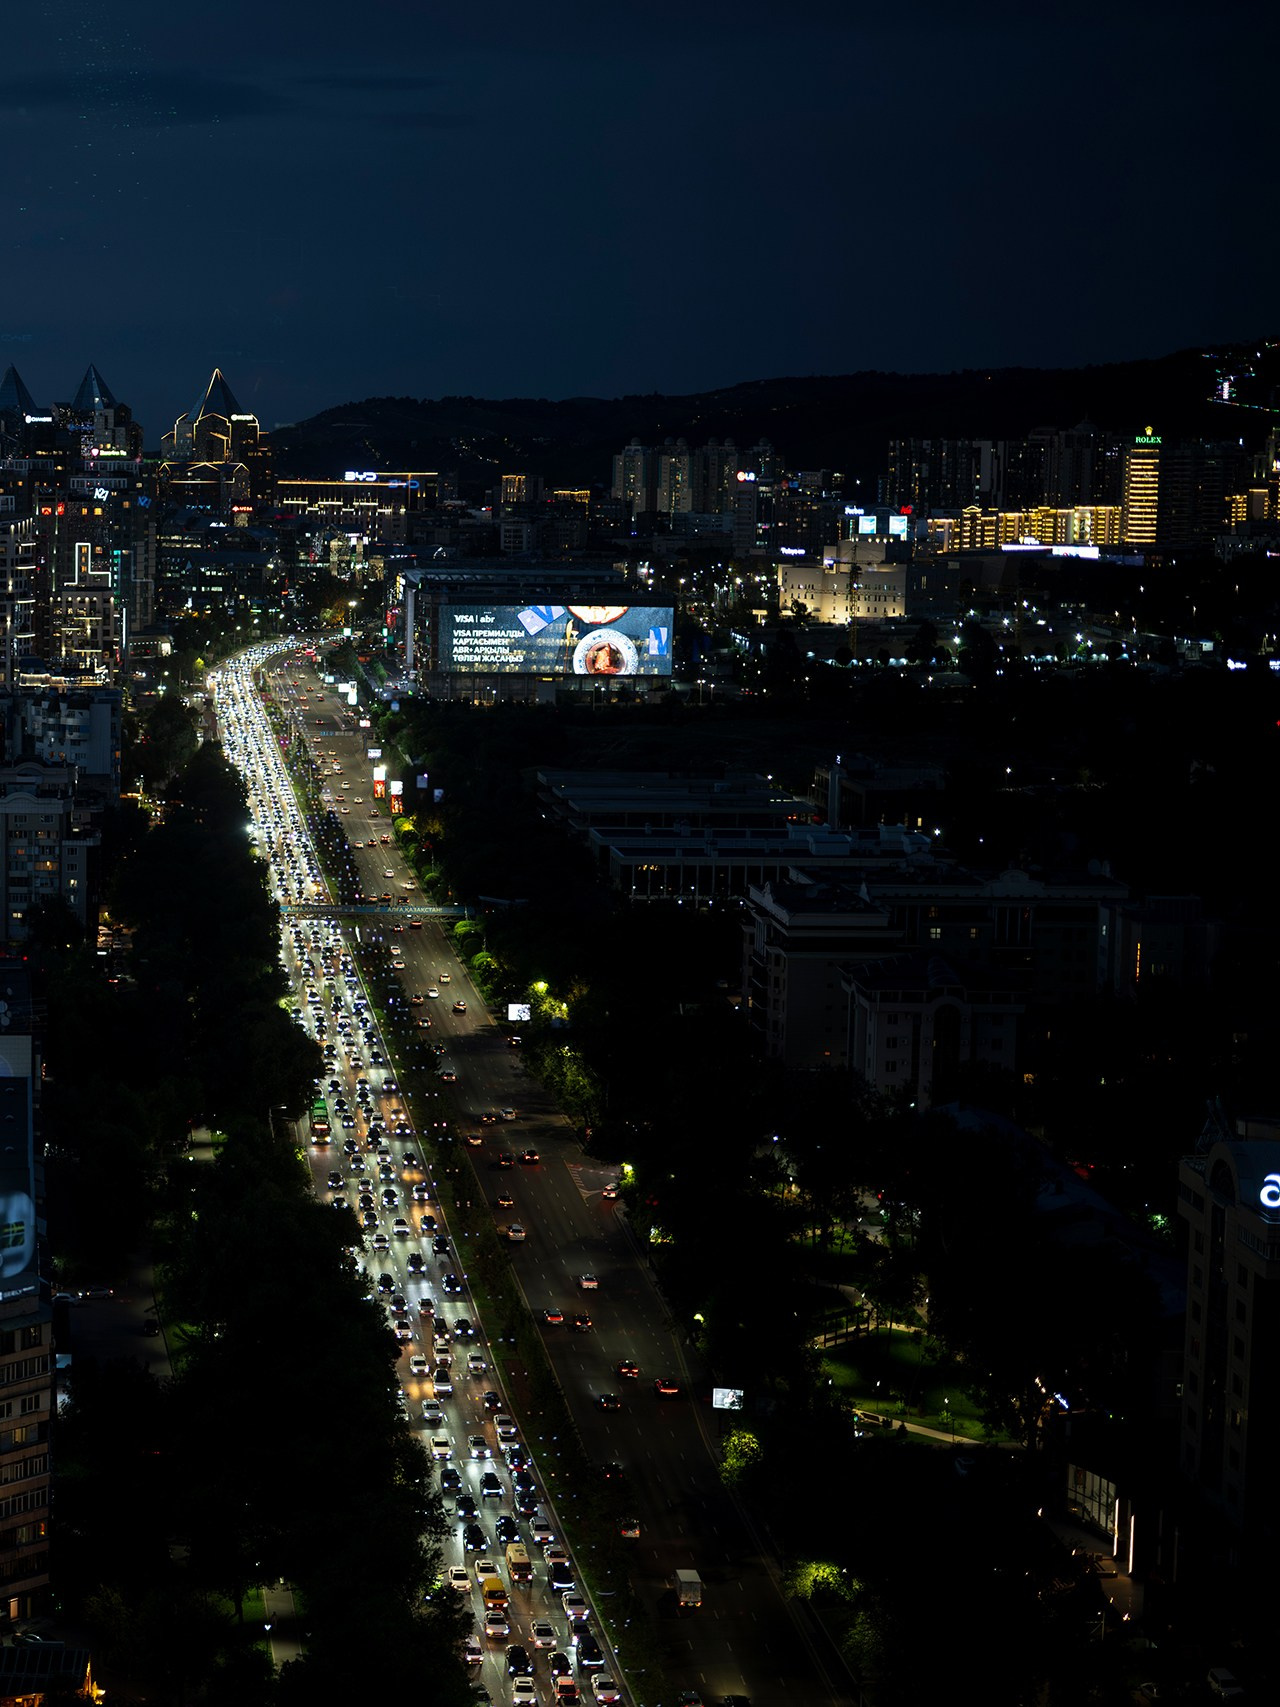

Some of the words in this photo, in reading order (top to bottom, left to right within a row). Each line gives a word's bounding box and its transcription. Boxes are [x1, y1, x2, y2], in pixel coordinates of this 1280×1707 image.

[1135, 436, 1162, 444] ROLEX
[345, 471, 377, 481] BYD
[454, 614, 474, 623] VISA
[479, 614, 495, 623] abr
[453, 630, 471, 638] VISA
[472, 630, 525, 639] ПРЕМИАЛДЫ
[453, 638, 508, 646] КАРТАСЫМЕН
[453, 655, 481, 663] ТӨЛЕМ
[482, 655, 524, 664] ЖАСАҢЫЗ
